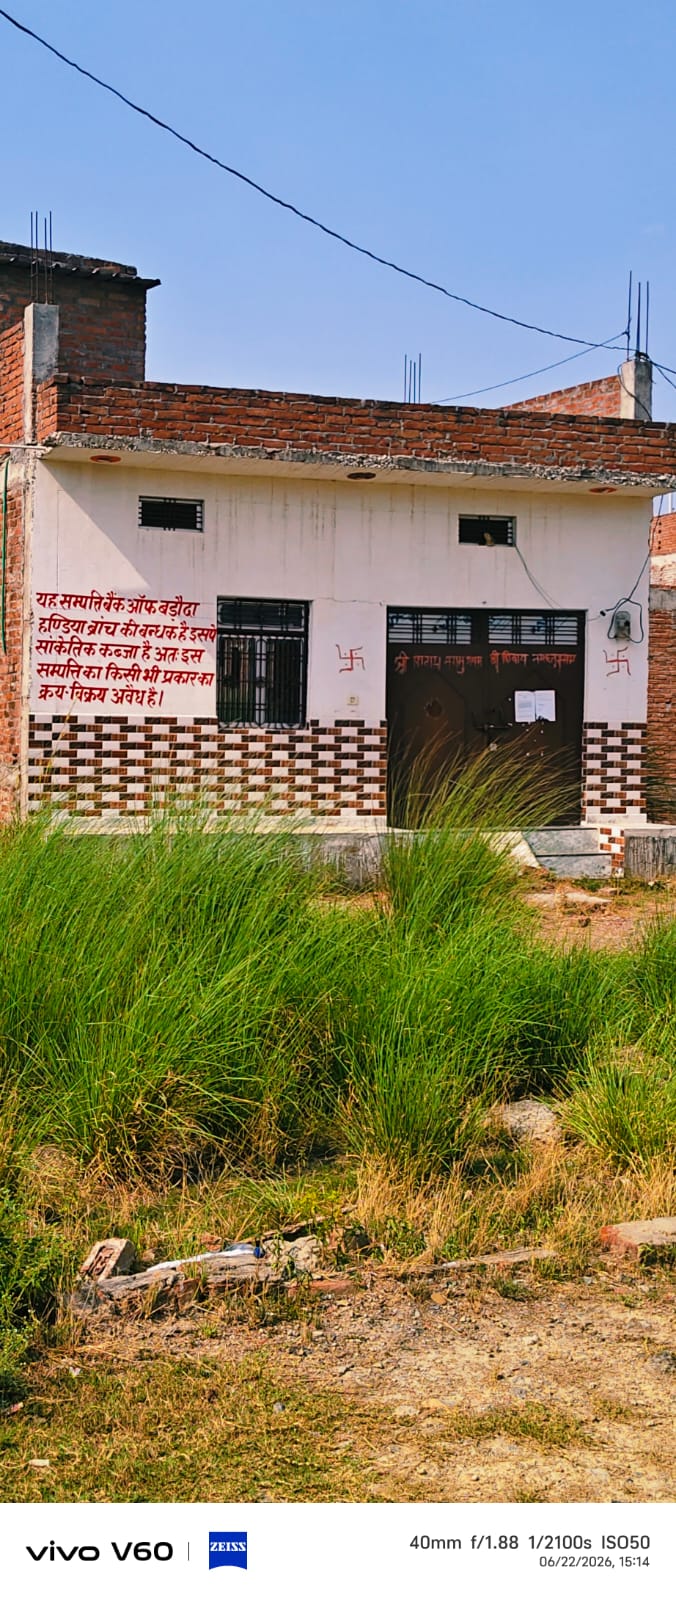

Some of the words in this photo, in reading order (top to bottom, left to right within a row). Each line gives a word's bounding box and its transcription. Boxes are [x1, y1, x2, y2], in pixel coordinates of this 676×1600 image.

[36, 593, 58, 609] यह
[59, 590, 105, 612] सम्पत्ति
[103, 591, 126, 612] बैंक
[128, 594, 158, 614] ऑफ
[38, 613, 87, 634] हण्डिया
[88, 616, 120, 636] ब्रांच
[120, 620, 140, 637] की
[178, 621, 190, 641] है
[35, 636, 97, 658] सांकेतिक
[99, 643, 140, 659] कब्जा
[141, 640, 152, 661] है
[181, 648, 205, 665] इस
[36, 658, 83, 679] सम्पत्ति
[83, 666, 103, 679] का
[105, 662, 142, 682] किसी
[143, 665, 161, 683] भी
[161, 670, 199, 686] प्रकार
[197, 672, 215, 686] का
[111, 684, 146, 706] अवैध
